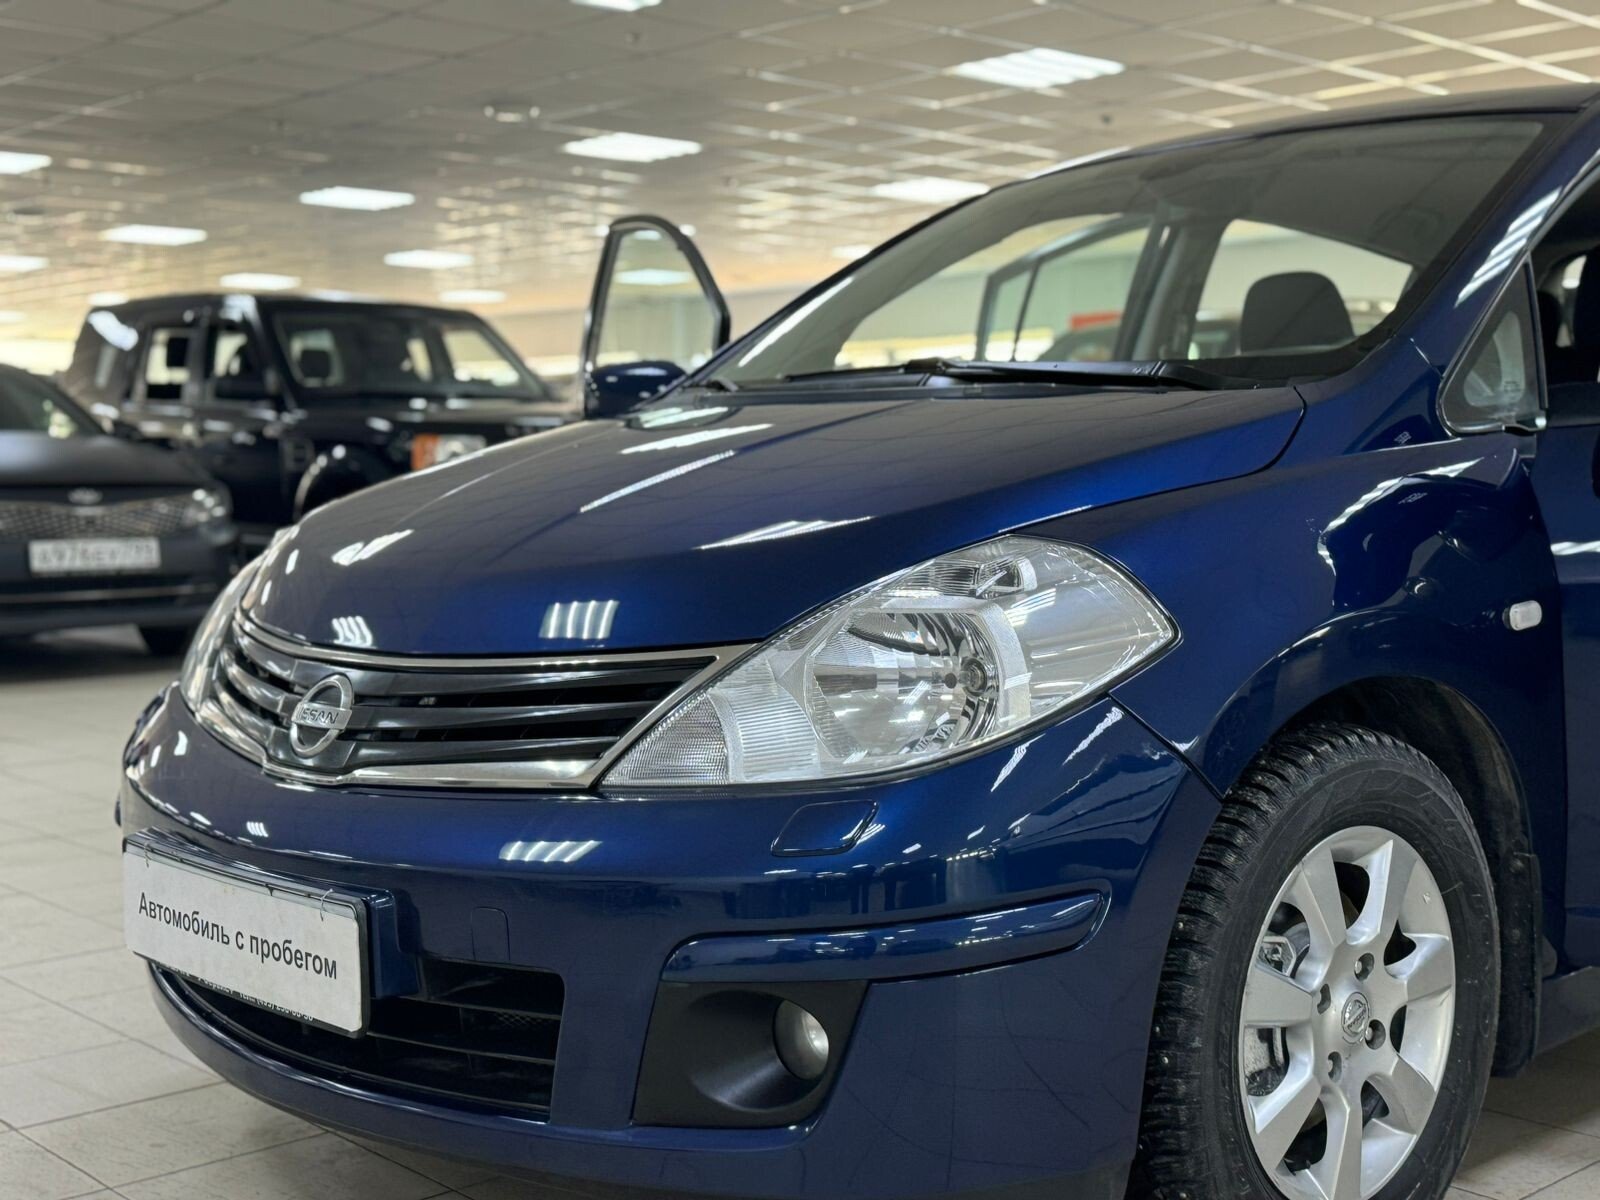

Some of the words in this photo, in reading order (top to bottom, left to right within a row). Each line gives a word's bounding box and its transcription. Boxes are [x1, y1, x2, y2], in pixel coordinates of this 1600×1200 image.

[138, 892, 230, 946] Автомобиль
[235, 931, 245, 951] с
[249, 934, 338, 980] пробегом
